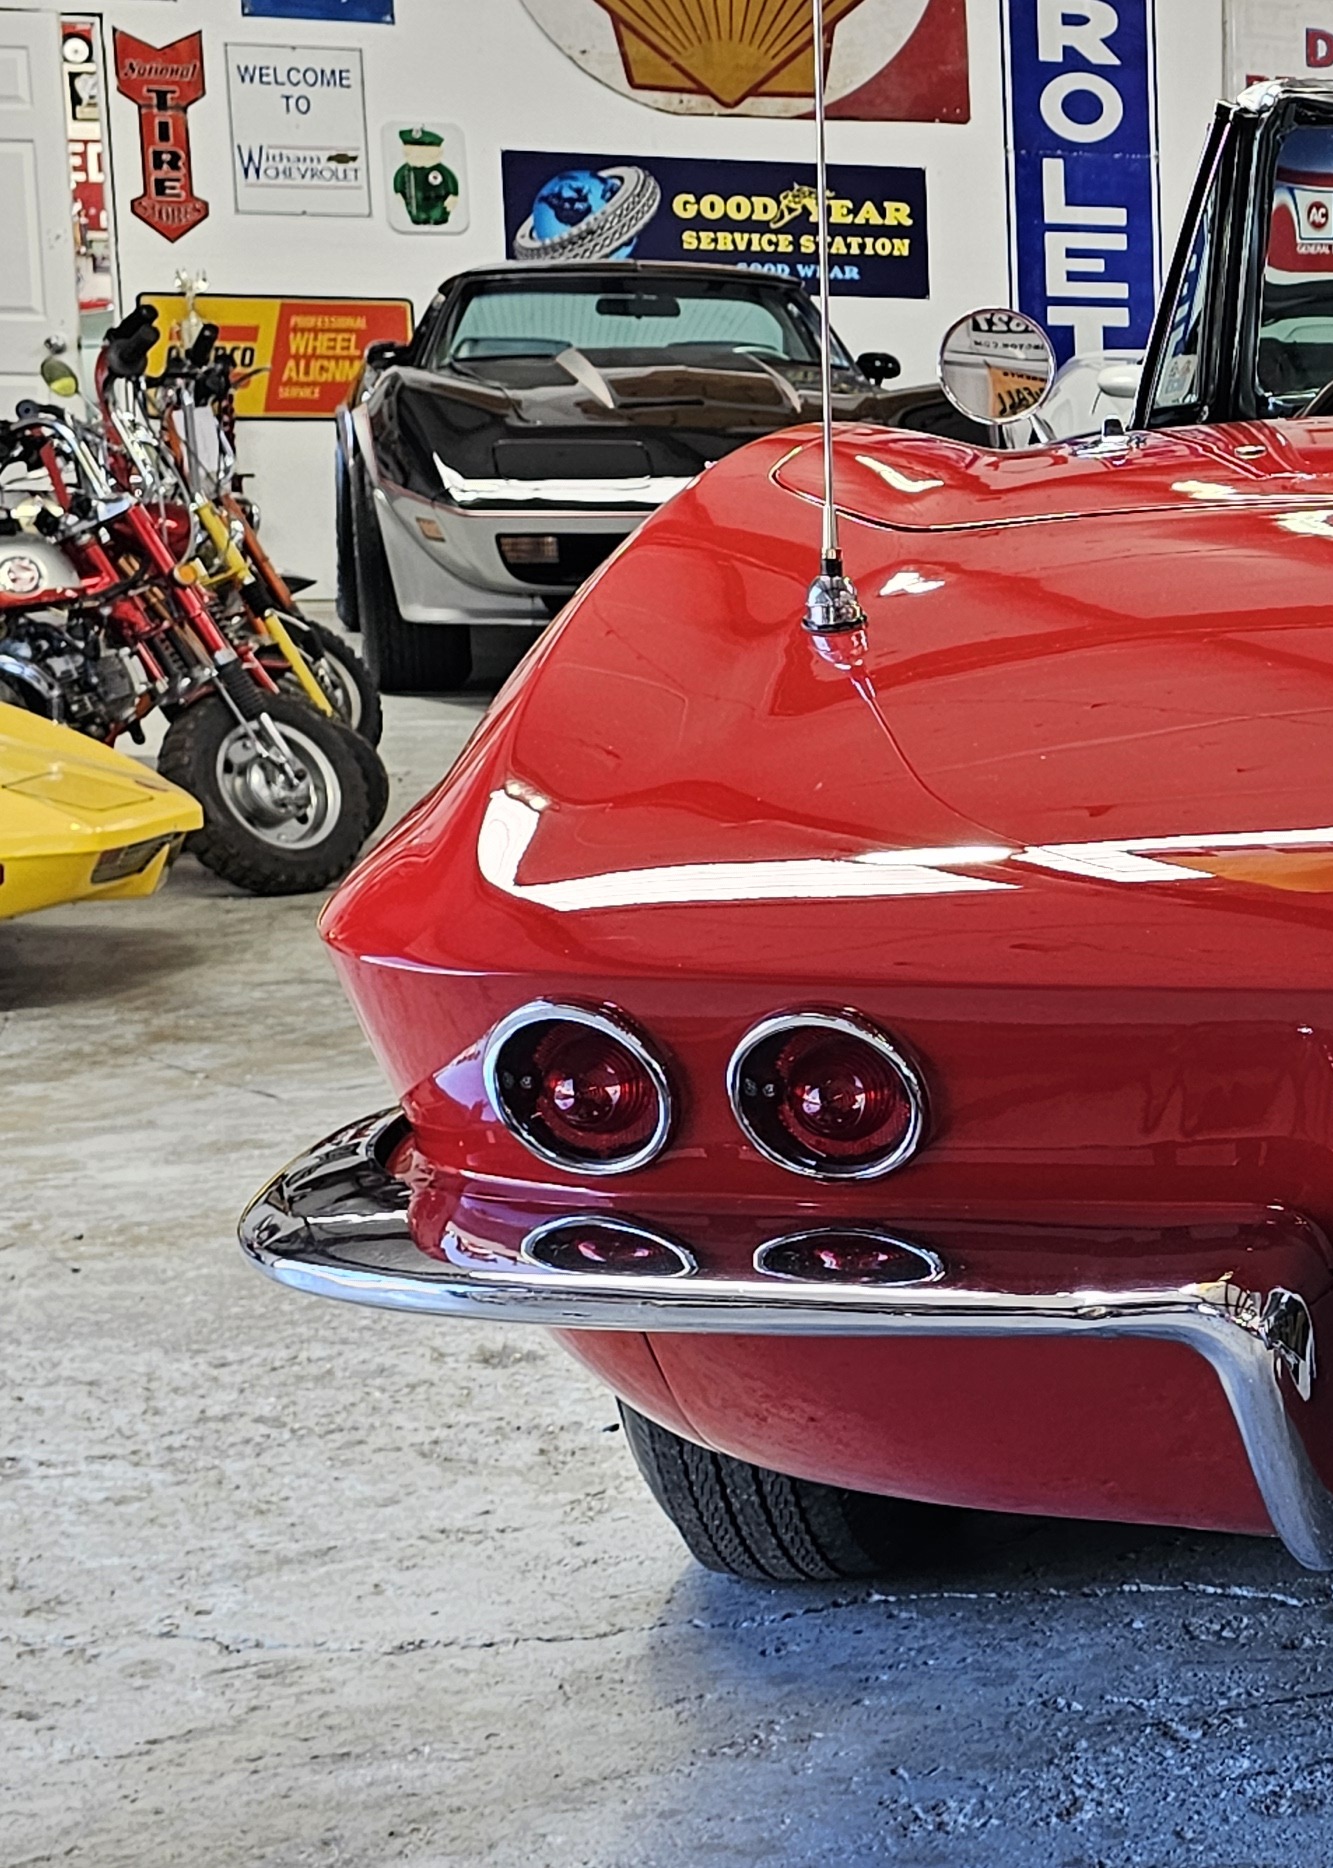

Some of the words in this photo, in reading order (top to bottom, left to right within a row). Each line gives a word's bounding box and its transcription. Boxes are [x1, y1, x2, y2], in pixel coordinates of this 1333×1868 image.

[123, 58, 199, 82] National
[236, 64, 352, 89] WELCOME
[280, 94, 312, 115] TO
[144, 85, 186, 199] TIRE
[236, 144, 322, 181] Witham
[264, 166, 361, 183] CHEVROLET
[671, 193, 914, 227] GOODYEAR
[1308, 206, 1328, 225] AC
[682, 230, 794, 253] SERVICE
[1296, 243, 1330, 255] GENERAL
[288, 331, 361, 356] WHEEL
[278, 384, 321, 400] SERVICE
